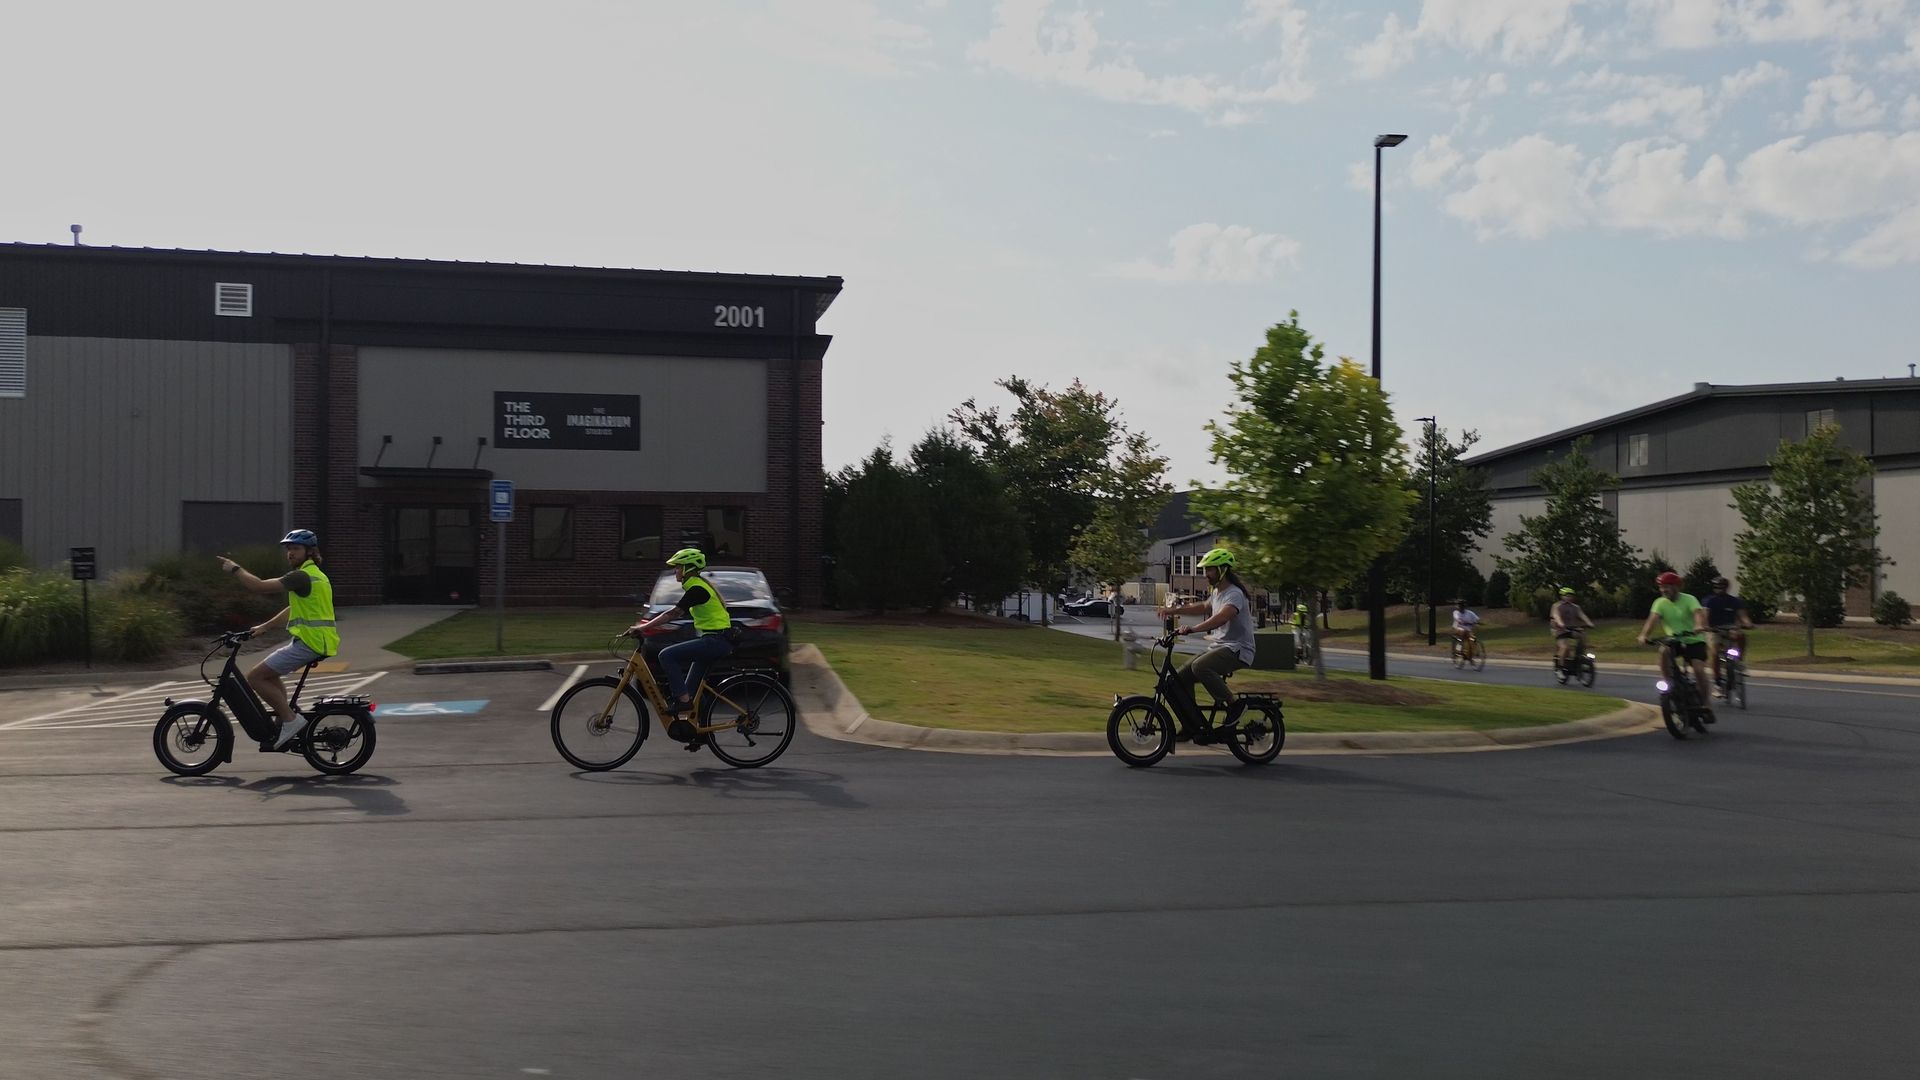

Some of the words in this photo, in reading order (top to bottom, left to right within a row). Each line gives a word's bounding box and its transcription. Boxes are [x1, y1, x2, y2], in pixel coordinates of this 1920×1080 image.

[714, 305, 764, 328] 2001
[504, 401, 531, 413] THE
[504, 414, 546, 426] THIRD
[566, 414, 632, 428] IMAGINARIUM
[504, 427, 551, 439] FLOOR
